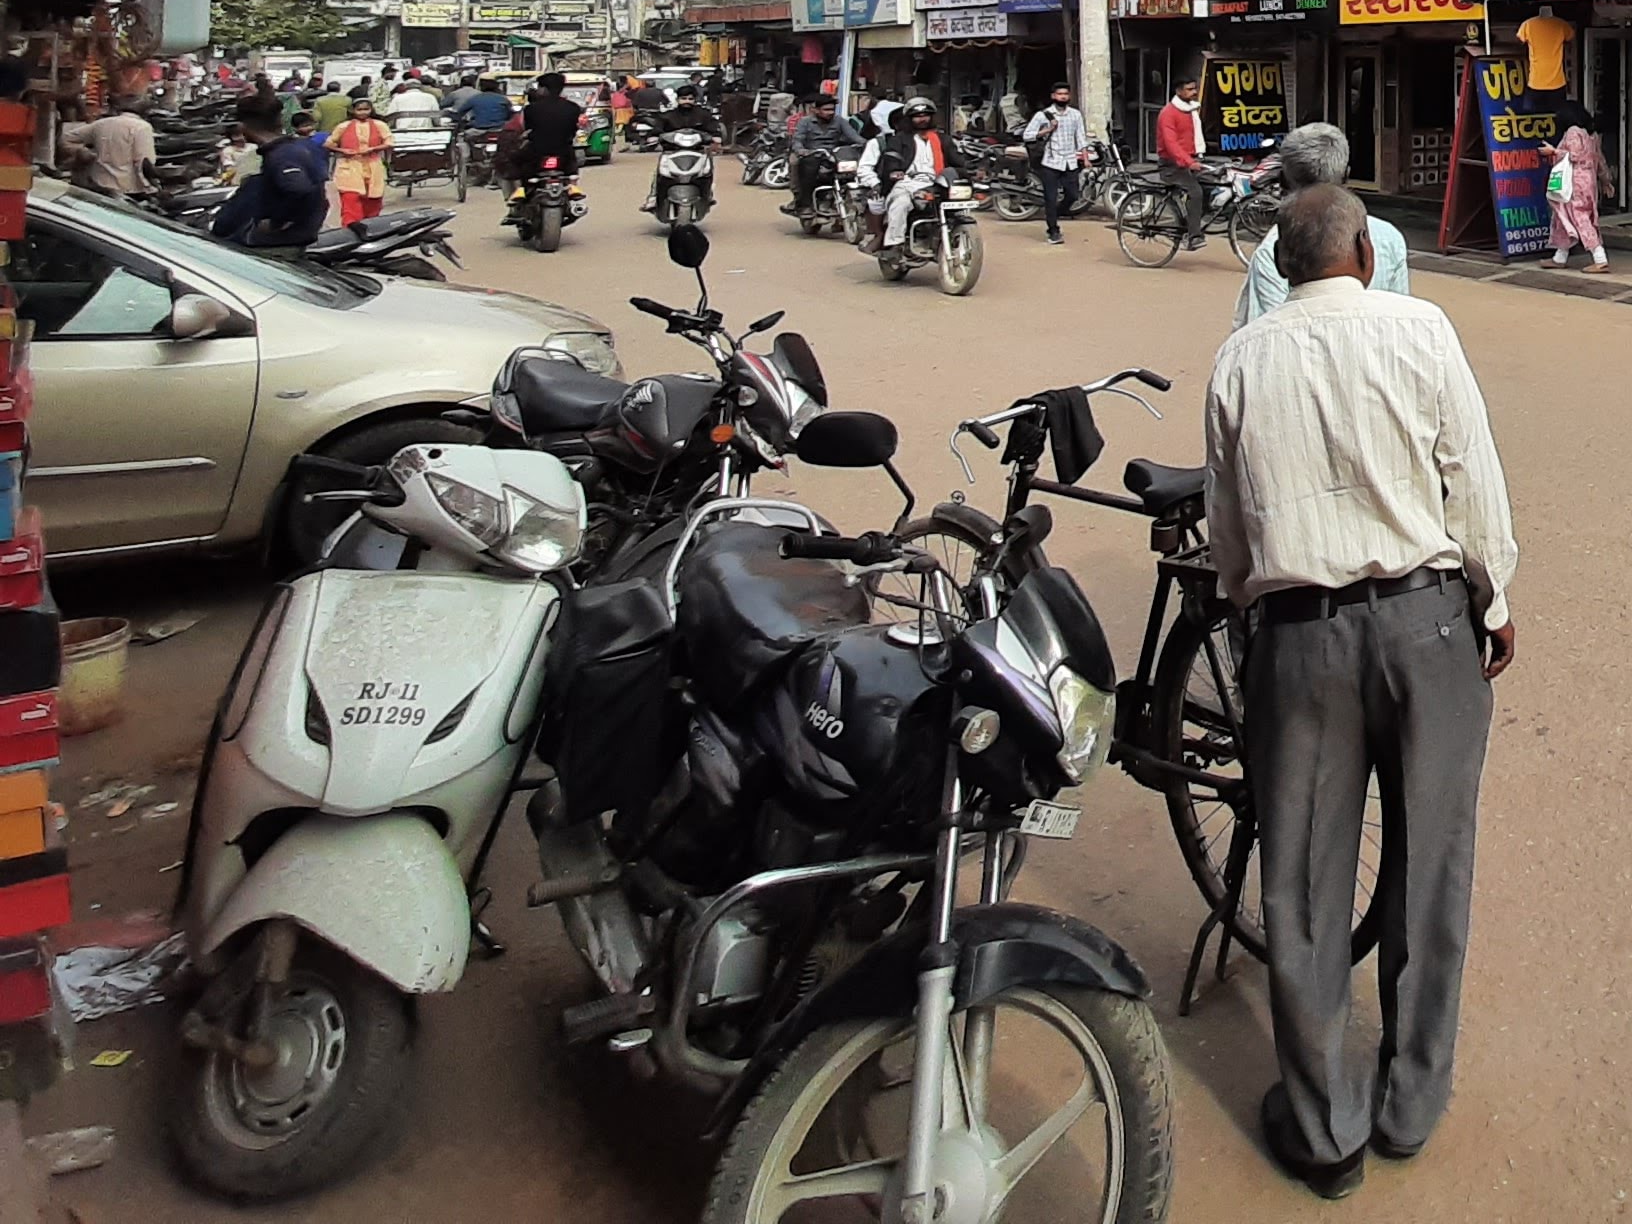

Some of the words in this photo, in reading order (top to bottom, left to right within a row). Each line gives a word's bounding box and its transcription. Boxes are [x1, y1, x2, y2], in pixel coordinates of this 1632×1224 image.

[1213, 60, 1282, 96] जगन
[1220, 98, 1284, 128] होटल
[1490, 106, 1557, 143] होटल
[1491, 149, 1540, 172] ROOMS
[1505, 226, 1550, 241] 961002
[340, 706, 427, 727] SD1299
[804, 701, 845, 739] Hero
